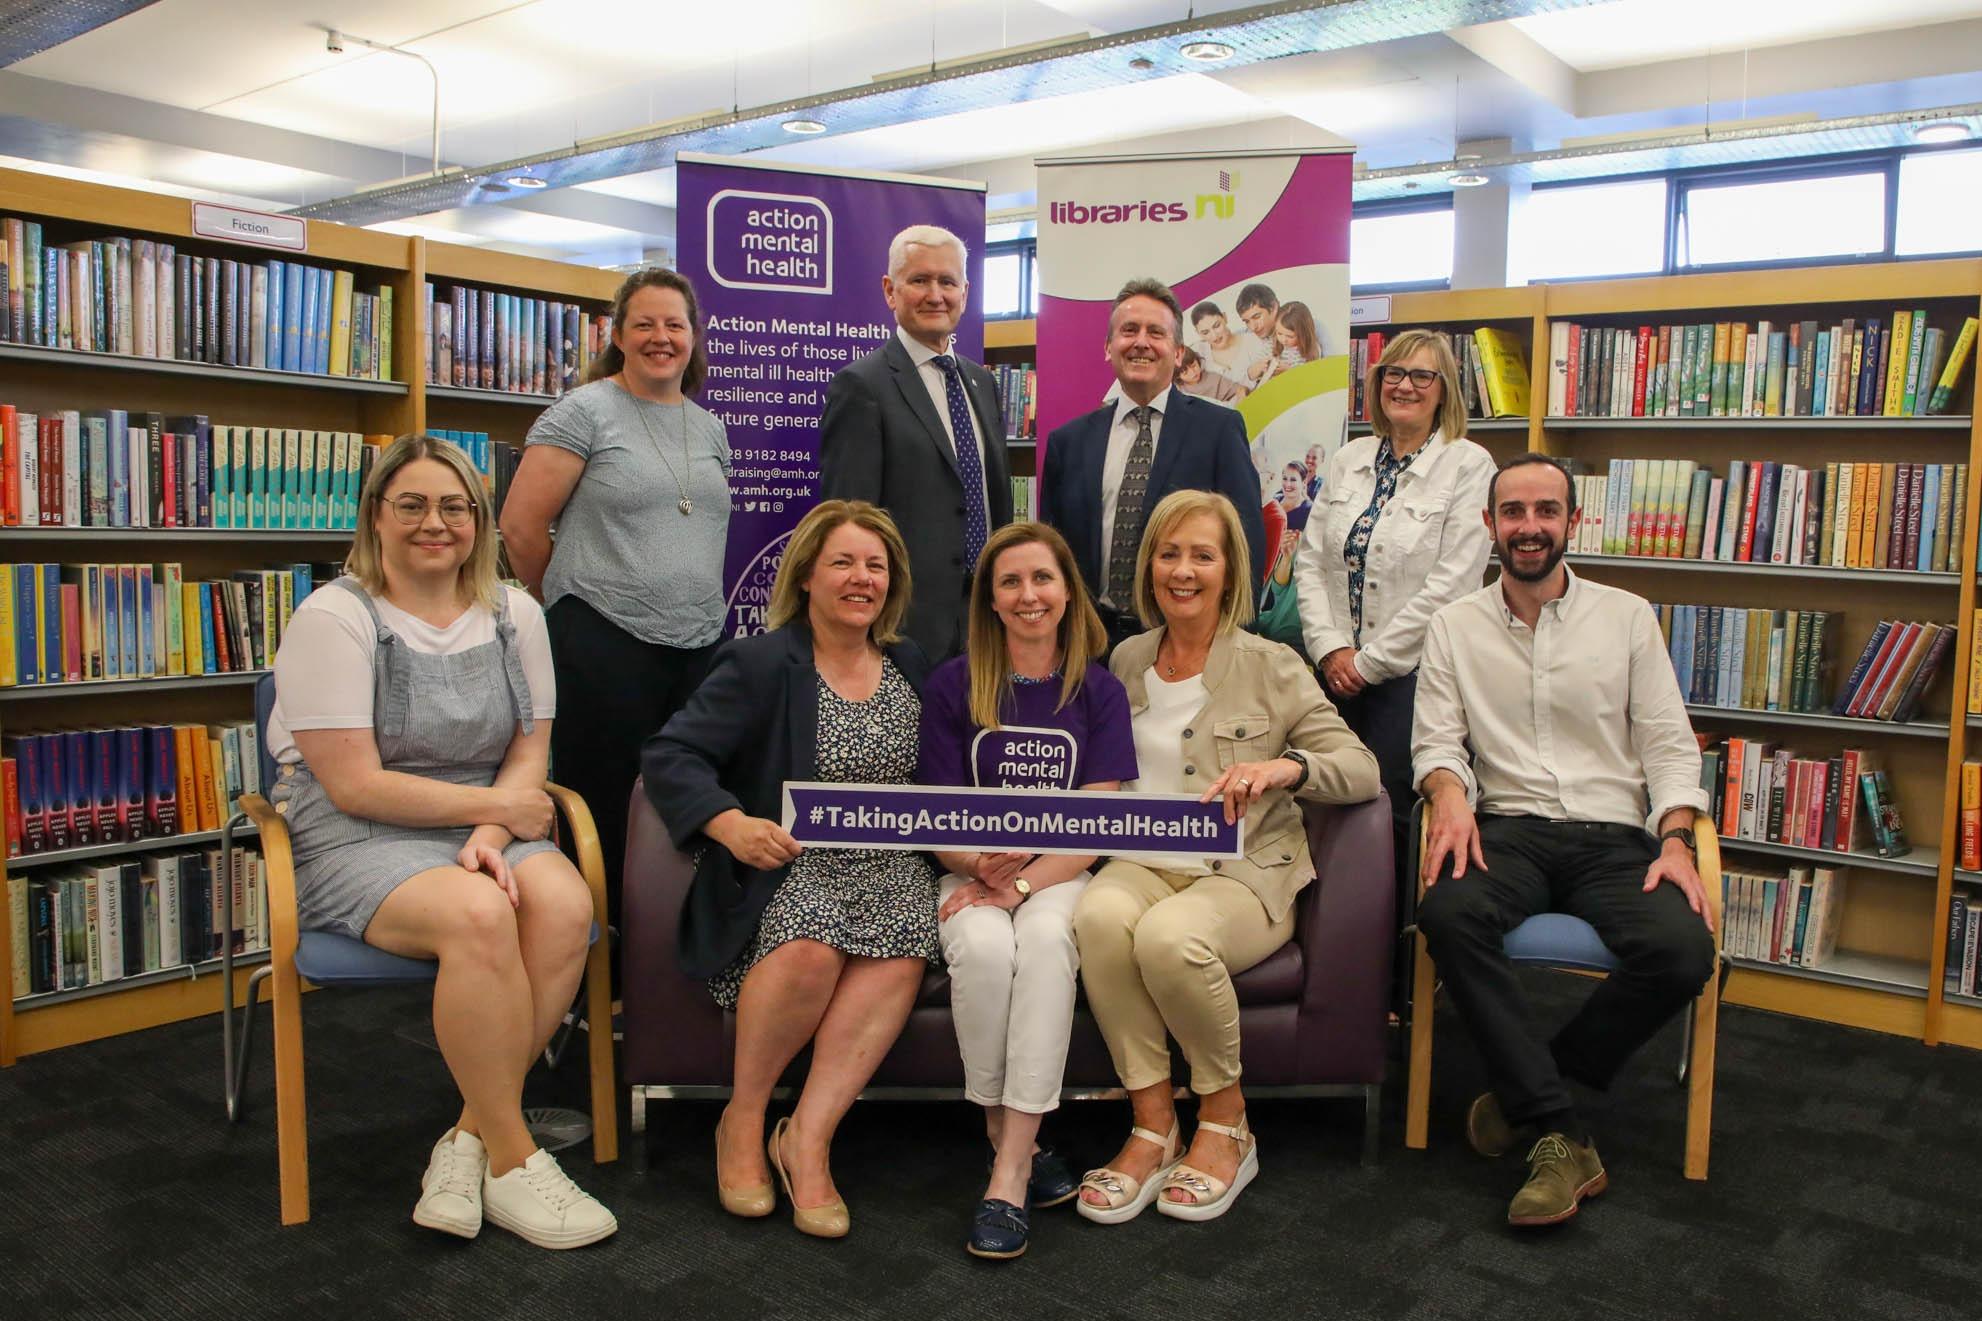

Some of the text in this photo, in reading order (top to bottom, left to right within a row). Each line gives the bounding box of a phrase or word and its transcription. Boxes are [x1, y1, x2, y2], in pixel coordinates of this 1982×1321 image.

[747, 208, 818, 231] action
[1050, 201, 1188, 224] libraries
[232, 218, 269, 234] Fiction
[741, 232, 818, 255] mental
[746, 254, 818, 279] health
[707, 315, 890, 341] Action Mental Health
[707, 338, 735, 355] the
[740, 340, 776, 358] lives
[781, 342, 799, 358] of
[803, 343, 847, 361] those
[1866, 326, 1877, 367] NICK
[707, 363, 835, 383] mental ill health
[707, 387, 784, 405] resilience
[788, 389, 817, 406] and
[151, 421, 159, 452] THREE
[745, 449, 777, 461] 9182
[780, 450, 811, 462] 8494
[1837, 465, 1852, 532] Danielle Steel
[1850, 466, 1866, 532] Danielle Steel
[1865, 466, 1881, 532] Danielle Steel
[1893, 469, 1909, 534] Danielle Steel
[1908, 469, 1923, 535] Danielle Steel
[1937, 509, 1948, 535] Steel
[1695, 609, 1708, 669] Danielle Steel
[1709, 609, 1720, 646] Danielle
[1794, 614, 1810, 678] Danielle Steel
[1809, 614, 1825, 679] Danielle Steel
[1849, 624, 1889, 684] Danielle Steel
[1732, 650, 1742, 672] Steel
[1004, 740, 1065, 759] action
[998, 760, 1065, 779] mental
[1743, 793, 1754, 812] COW
[809, 805, 1218, 839] #TakingActionOnMentalHealth
[1965, 839, 1974, 859] FIELDS
[1953, 901, 1962, 915] Our
